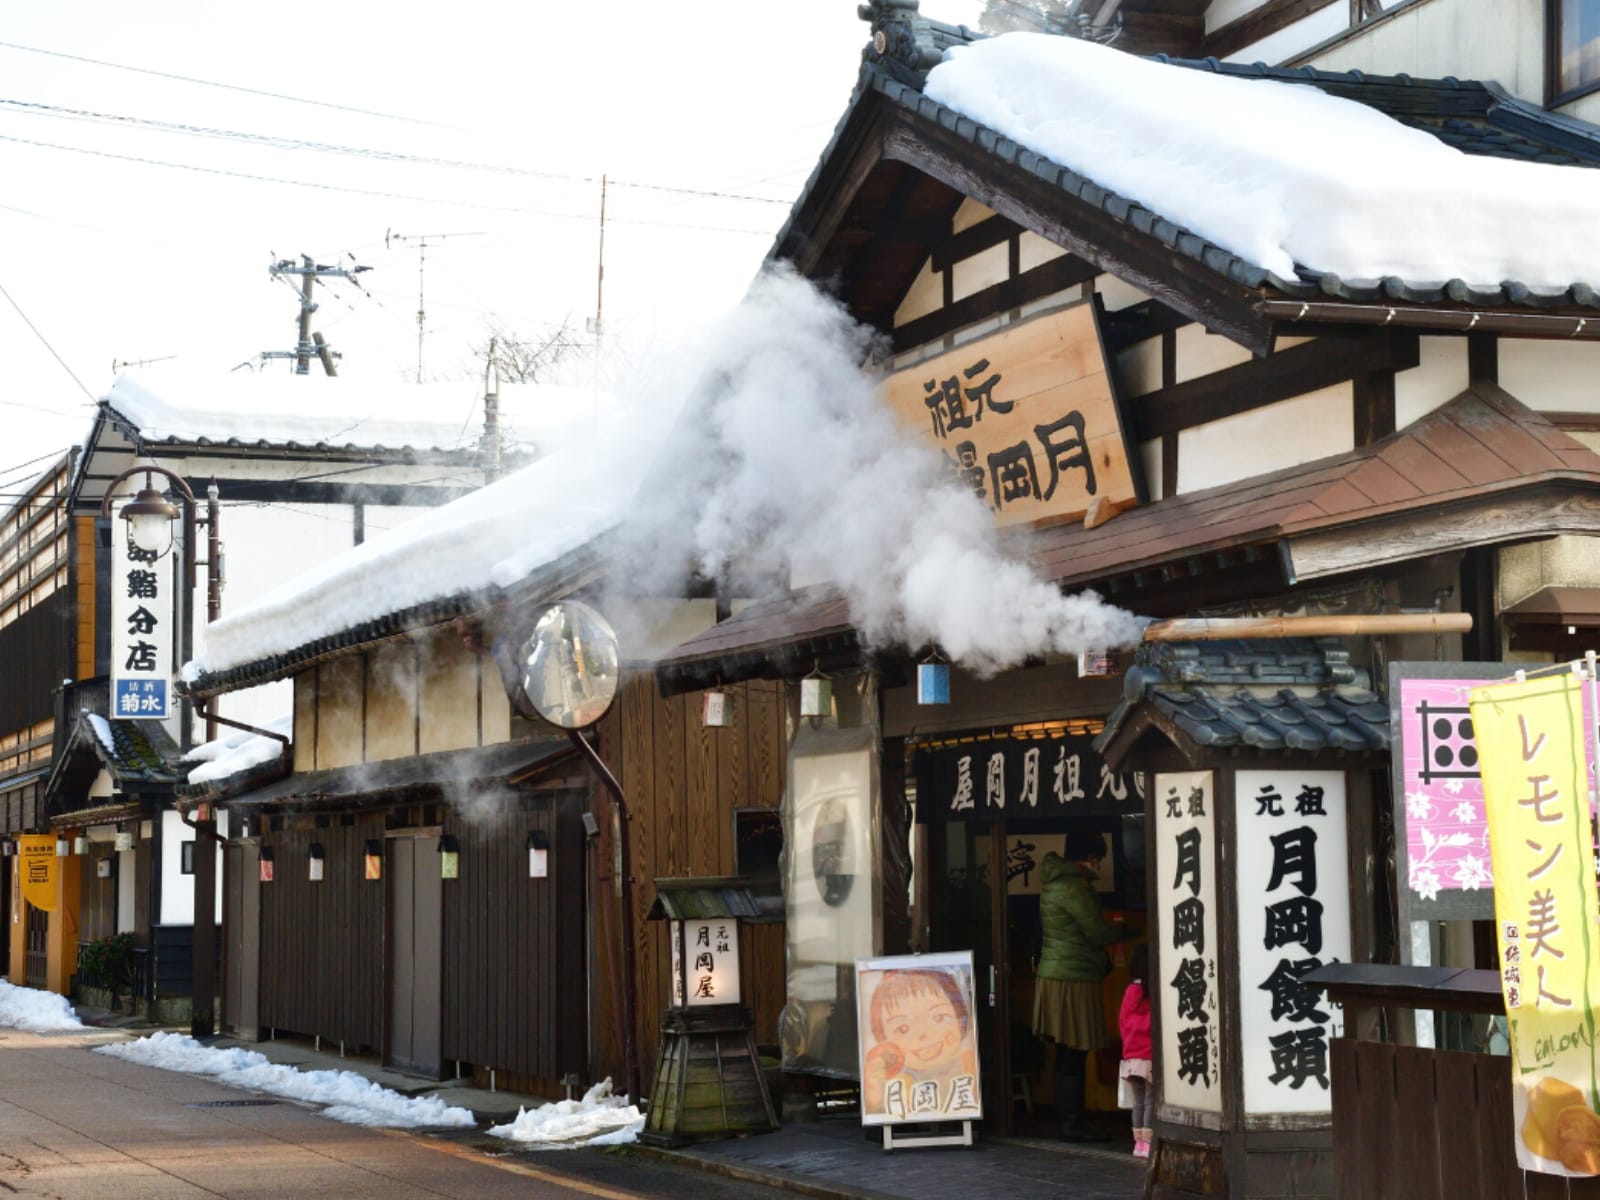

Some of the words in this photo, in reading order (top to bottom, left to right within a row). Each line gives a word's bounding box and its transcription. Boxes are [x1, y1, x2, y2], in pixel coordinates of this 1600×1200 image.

[924, 358, 1014, 439] 元祖
[121, 693, 162, 713] 菊水
[1166, 786, 1206, 818] 元祖
[1255, 784, 1327, 817] 元祖
[1517, 714, 1571, 1006] レモン美人
[694, 925, 715, 998] 月岡屋
[716, 925, 730, 954] 元祖
[1171, 825, 1210, 1090] 月岡饅頭
[1257, 825, 1330, 1091] 月岡饅頭
[886, 1076, 979, 1120] 月岡屋
